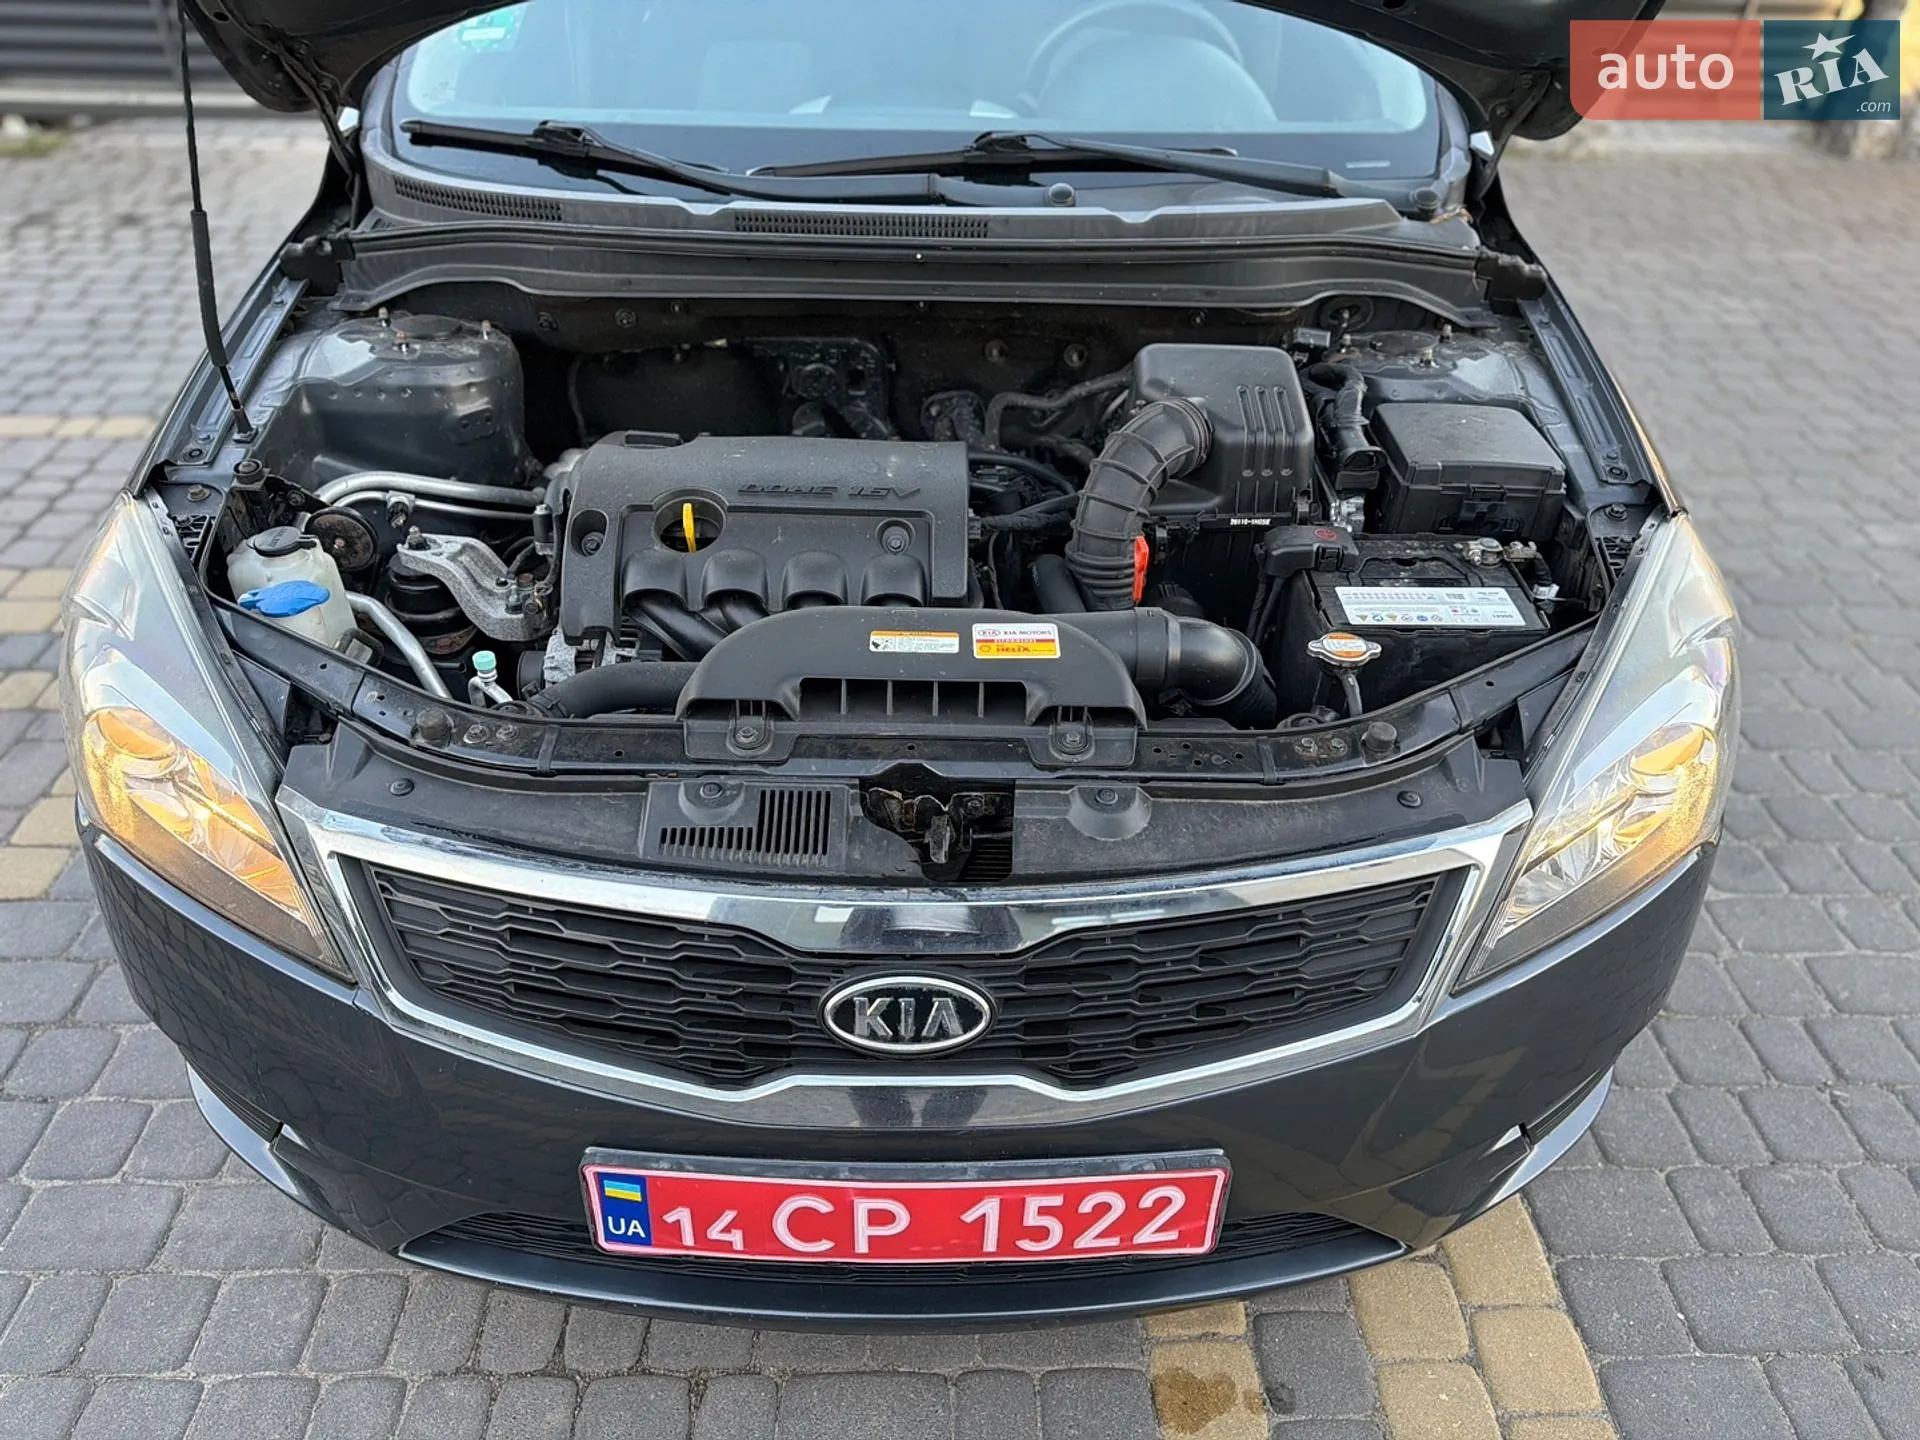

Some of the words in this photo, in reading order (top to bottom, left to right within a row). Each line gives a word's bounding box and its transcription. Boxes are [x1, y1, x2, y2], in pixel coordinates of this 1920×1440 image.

[853, 997, 964, 1038] KIA
[607, 1215, 647, 1239] UA
[661, 1205, 745, 1251] 14
[771, 1194, 912, 1254] CP
[958, 1185, 1187, 1252] 1522
